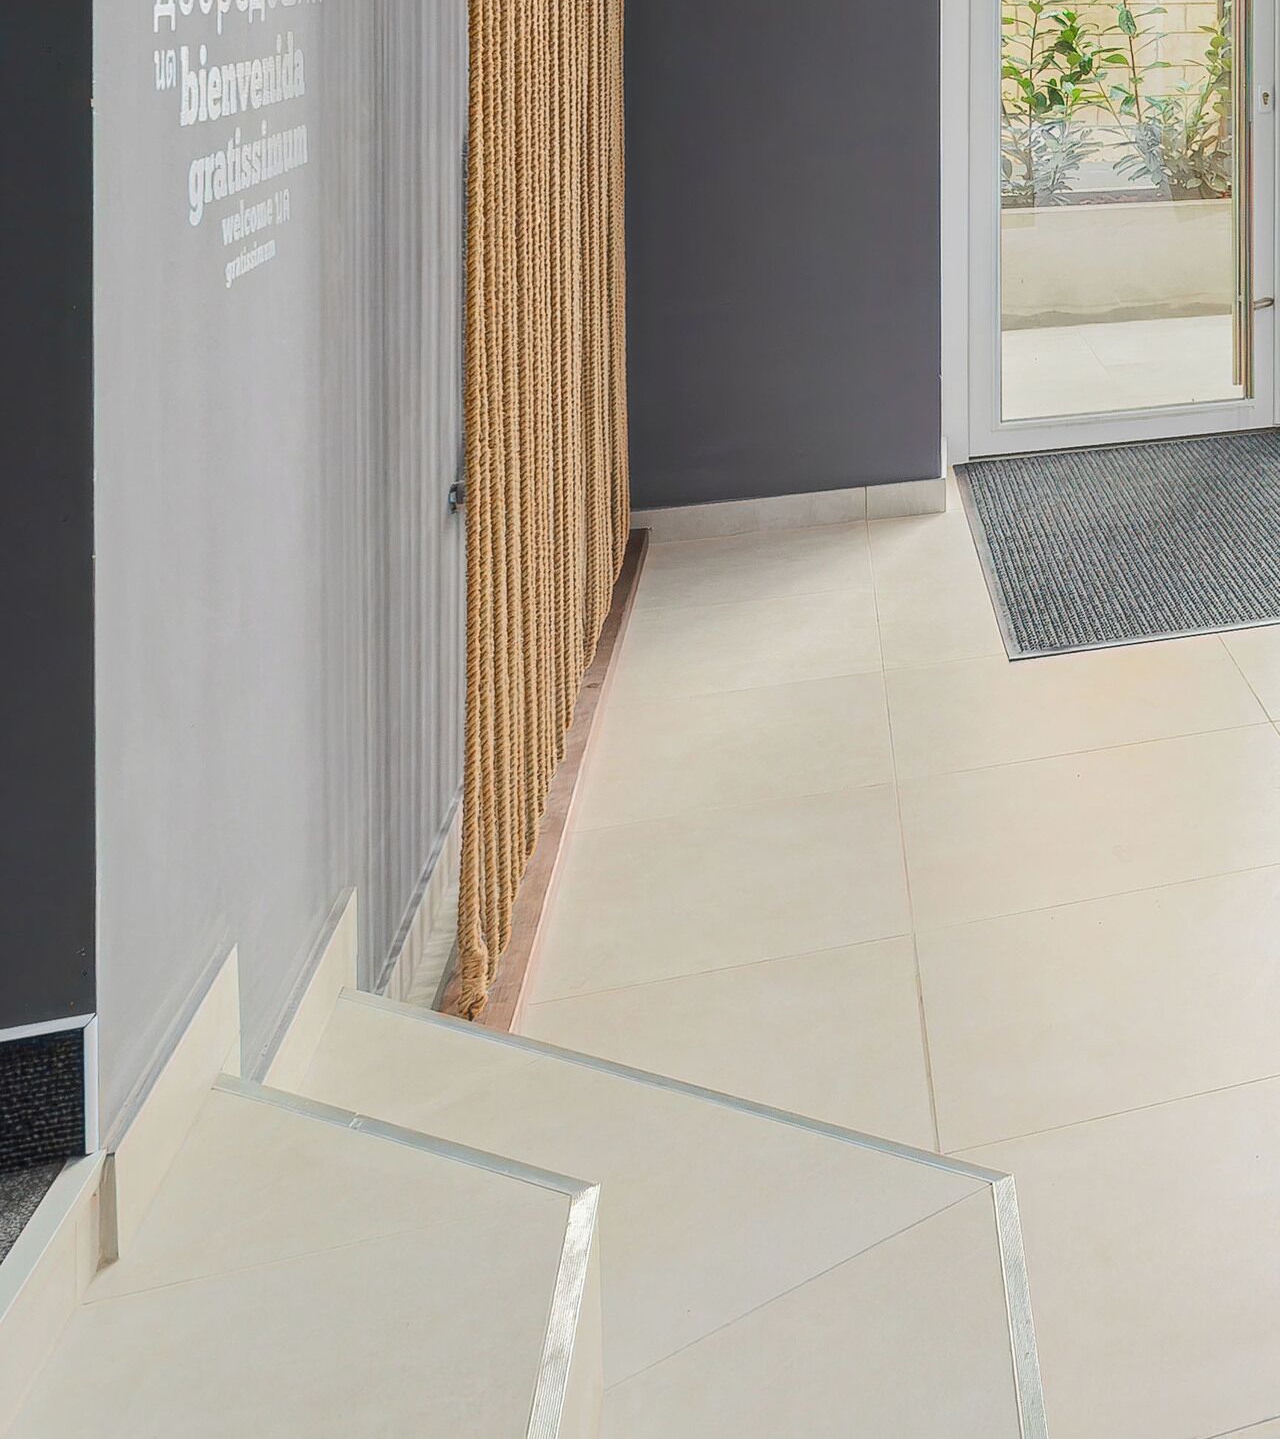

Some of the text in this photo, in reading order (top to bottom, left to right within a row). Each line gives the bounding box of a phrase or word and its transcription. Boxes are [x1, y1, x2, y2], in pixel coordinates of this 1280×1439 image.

[180, 31, 305, 127] bienvenida
[188, 119, 308, 226] gratissimum
[222, 199, 273, 246] welcome
